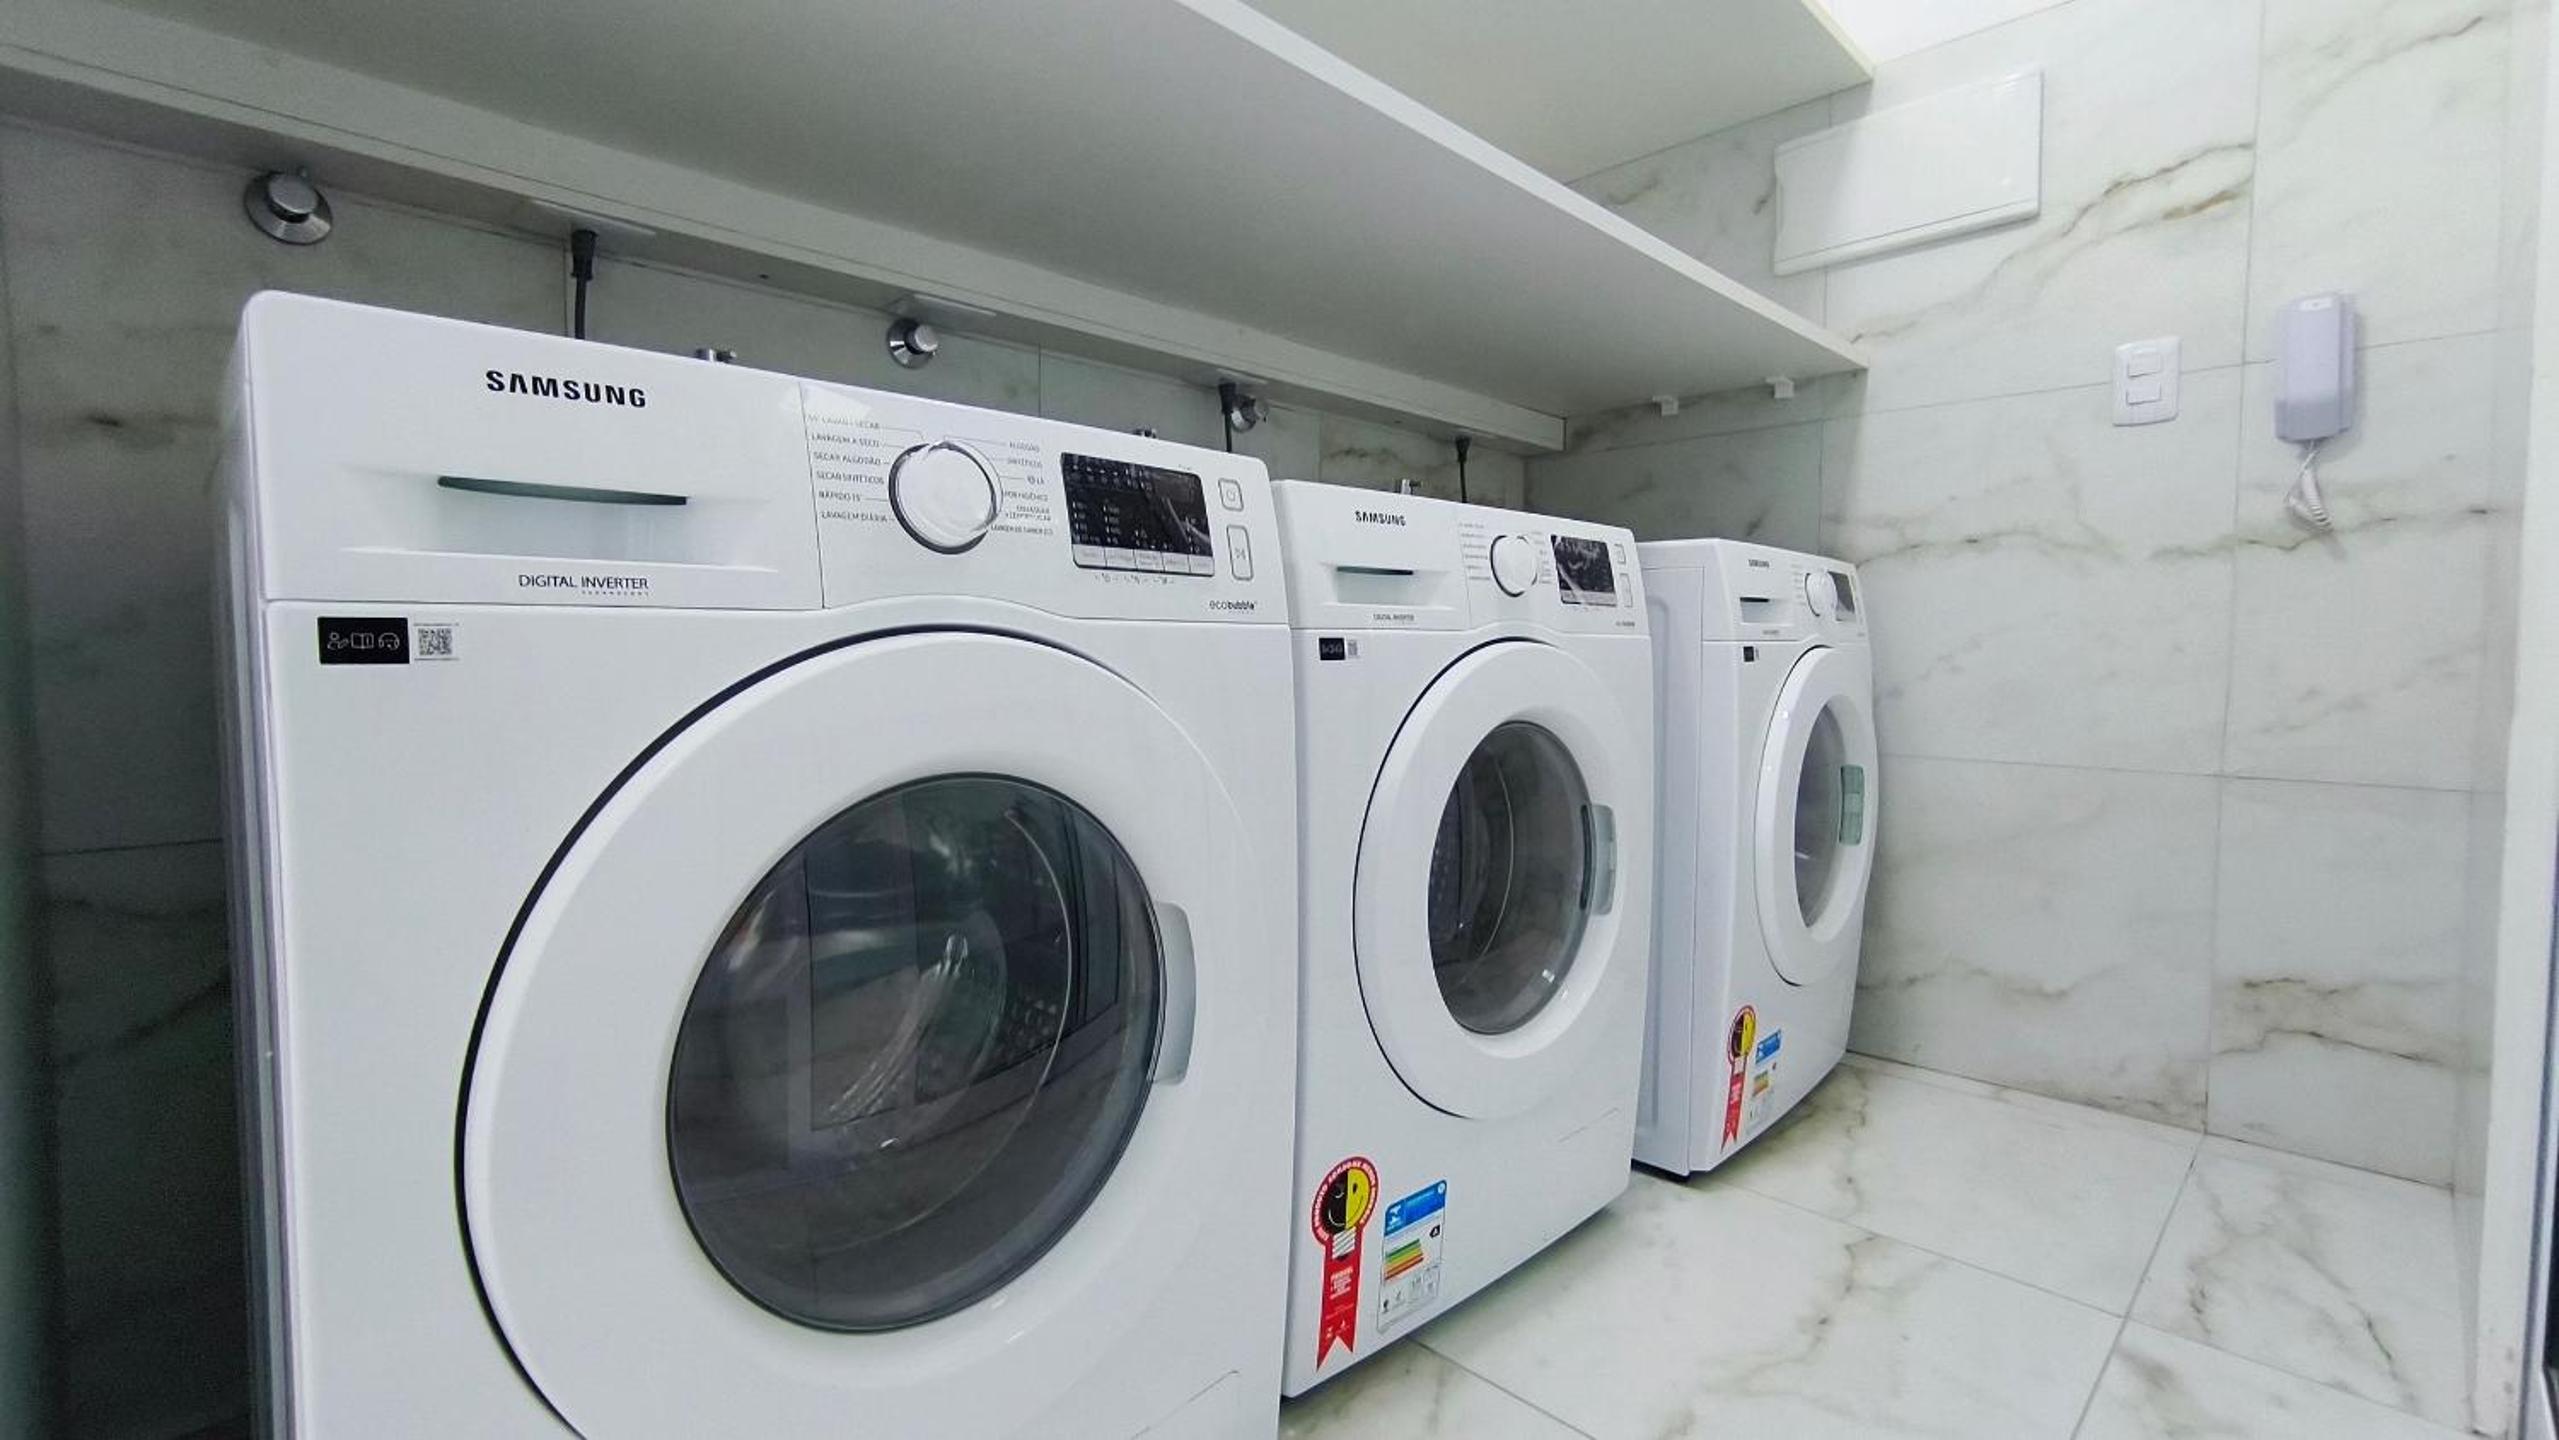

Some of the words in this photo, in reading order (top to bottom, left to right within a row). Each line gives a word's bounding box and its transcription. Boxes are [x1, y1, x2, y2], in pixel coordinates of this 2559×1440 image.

[485, 369, 647, 408] SAMSUNG
[813, 451, 840, 462] SECAR
[816, 470, 842, 481] SECAR
[1354, 510, 1407, 527] SAMSUNG
[518, 574, 578, 588] DIGITAL
[580, 575, 649, 590] INVERTER
[1209, 600, 1255, 610] ecobubble
